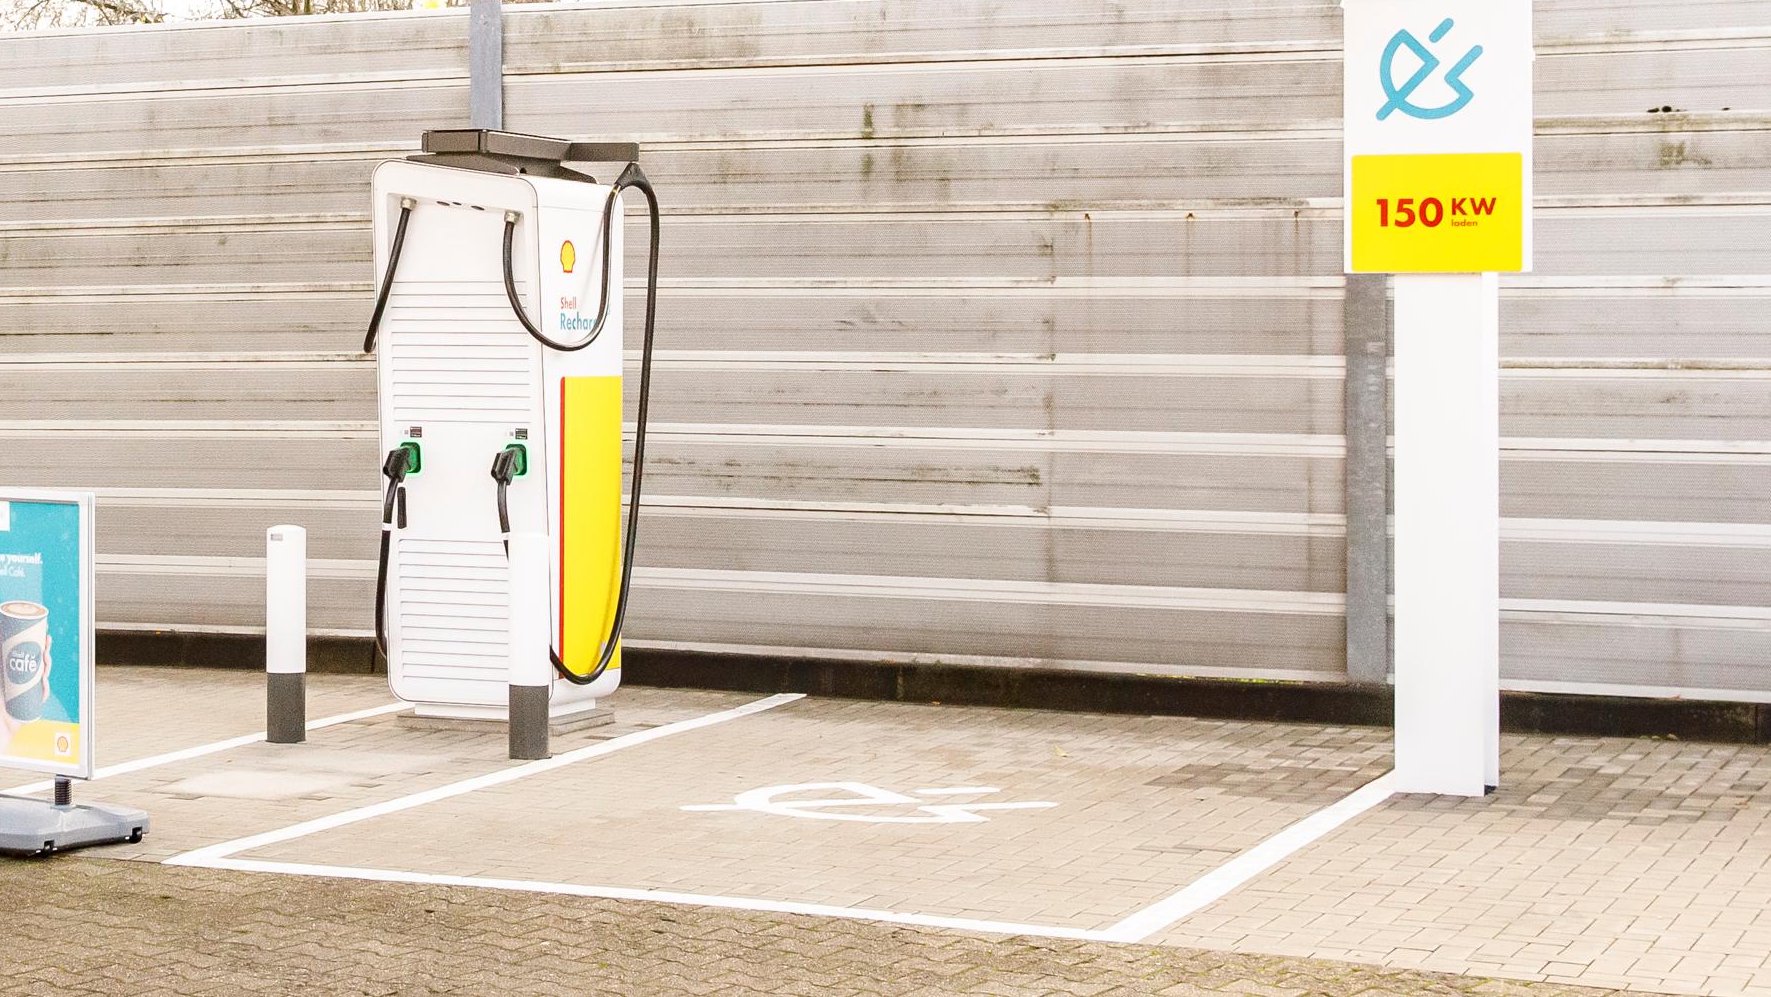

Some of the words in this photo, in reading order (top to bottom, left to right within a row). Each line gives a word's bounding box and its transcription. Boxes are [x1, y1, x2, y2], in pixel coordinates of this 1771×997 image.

[1376, 197, 1444, 228] 150
[1451, 197, 1497, 216] KW
[1451, 219, 1478, 227] laden
[560, 296, 577, 310] Shell
[6, 552, 44, 565] yourself.
